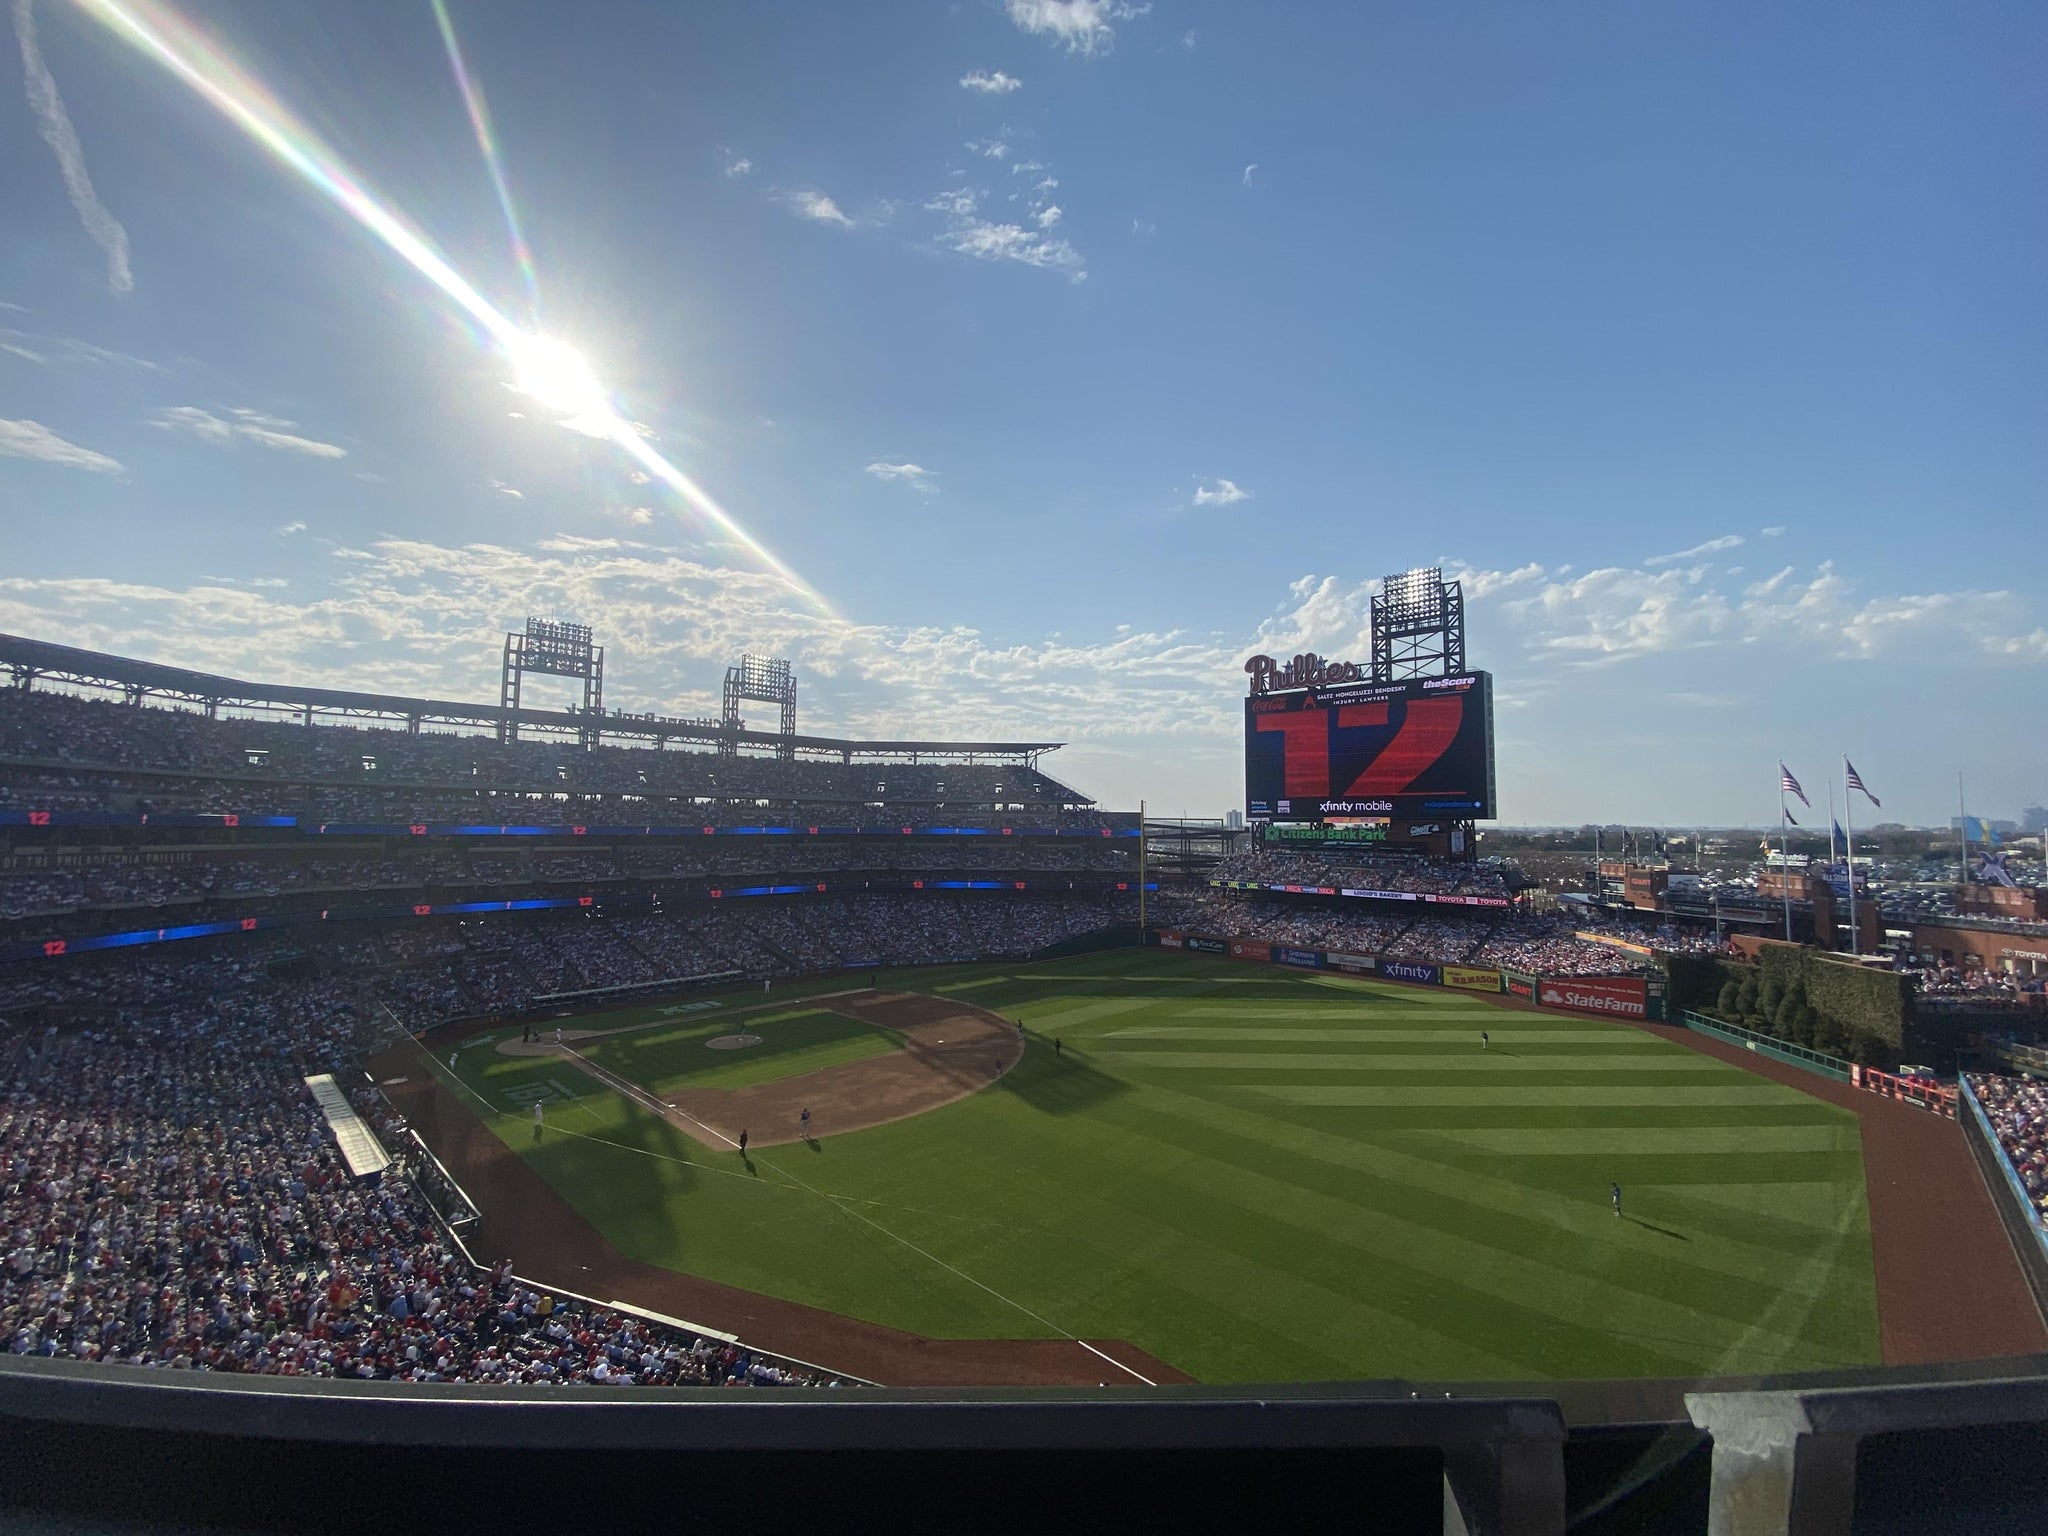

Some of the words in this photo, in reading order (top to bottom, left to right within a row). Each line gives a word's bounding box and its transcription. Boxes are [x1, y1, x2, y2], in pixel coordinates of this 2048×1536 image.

[1244, 652, 1360, 694] Phillies
[1423, 677, 1475, 690] theScore
[1360, 695, 1389, 703] LAWYERS
[1257, 695, 1467, 797] 12
[1320, 801, 1353, 812] xfinity
[1355, 800, 1392, 811] mobile
[30, 811, 50, 825] 12
[224, 815, 239, 826] 12
[409, 825, 427, 835] 12
[573, 826, 587, 835] 12
[703, 827, 714, 835] 12
[1281, 829, 1326, 840] Citizens
[1327, 829, 1356, 840] Bank
[1358, 828, 1387, 841] Park
[27, 857, 49, 868] THE
[146, 853, 192, 864] PHILLIES
[711, 890, 722, 898] 12
[579, 897, 593, 906] 12
[1438, 895, 1464, 903] TOYOTA
[1480, 898, 1508, 906] TOYOTA
[413, 905, 431, 915] 12
[241, 918, 256, 929] 12
[1161, 937, 1182, 947] Wawa
[44, 940, 66, 956] 12
[2014, 950, 2048, 960] TOYOTA
[1385, 963, 1432, 980] xfinity
[1510, 982, 1533, 996] GIANT
